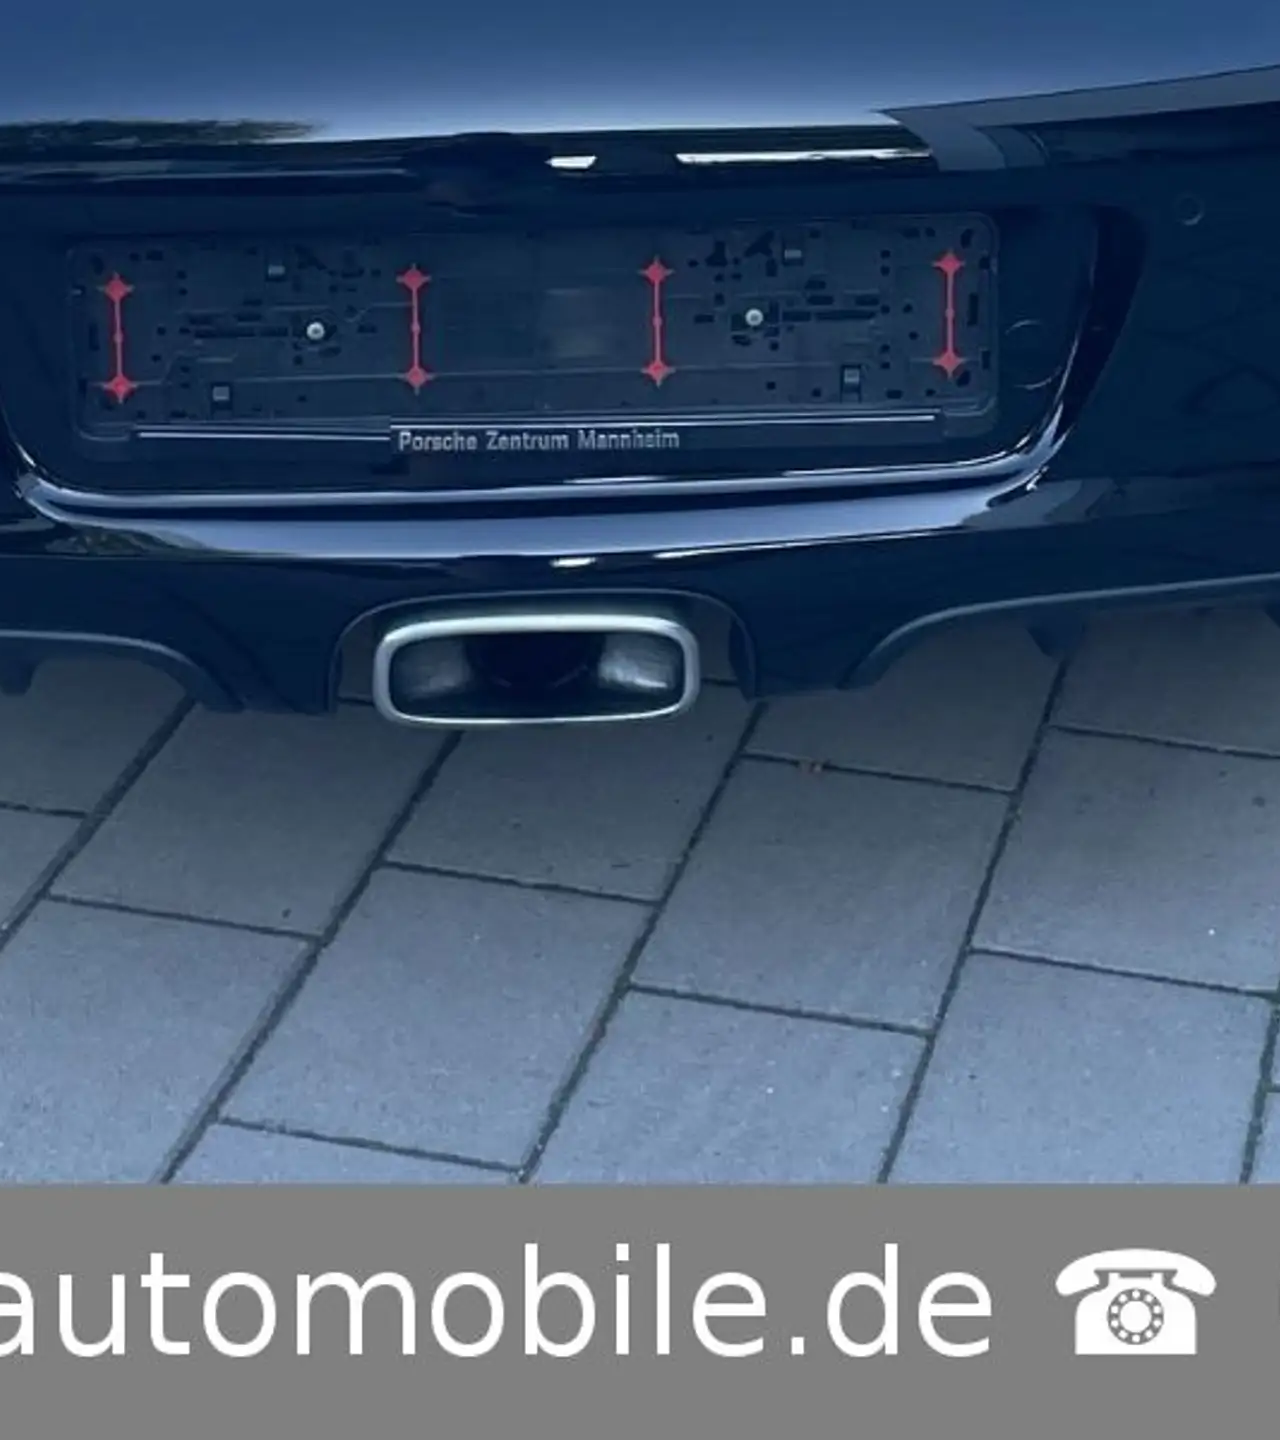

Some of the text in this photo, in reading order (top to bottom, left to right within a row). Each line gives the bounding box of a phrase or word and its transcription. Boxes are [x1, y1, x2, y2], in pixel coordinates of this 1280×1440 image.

[398, 427, 680, 452] Porsche Zentrum Mannheim
